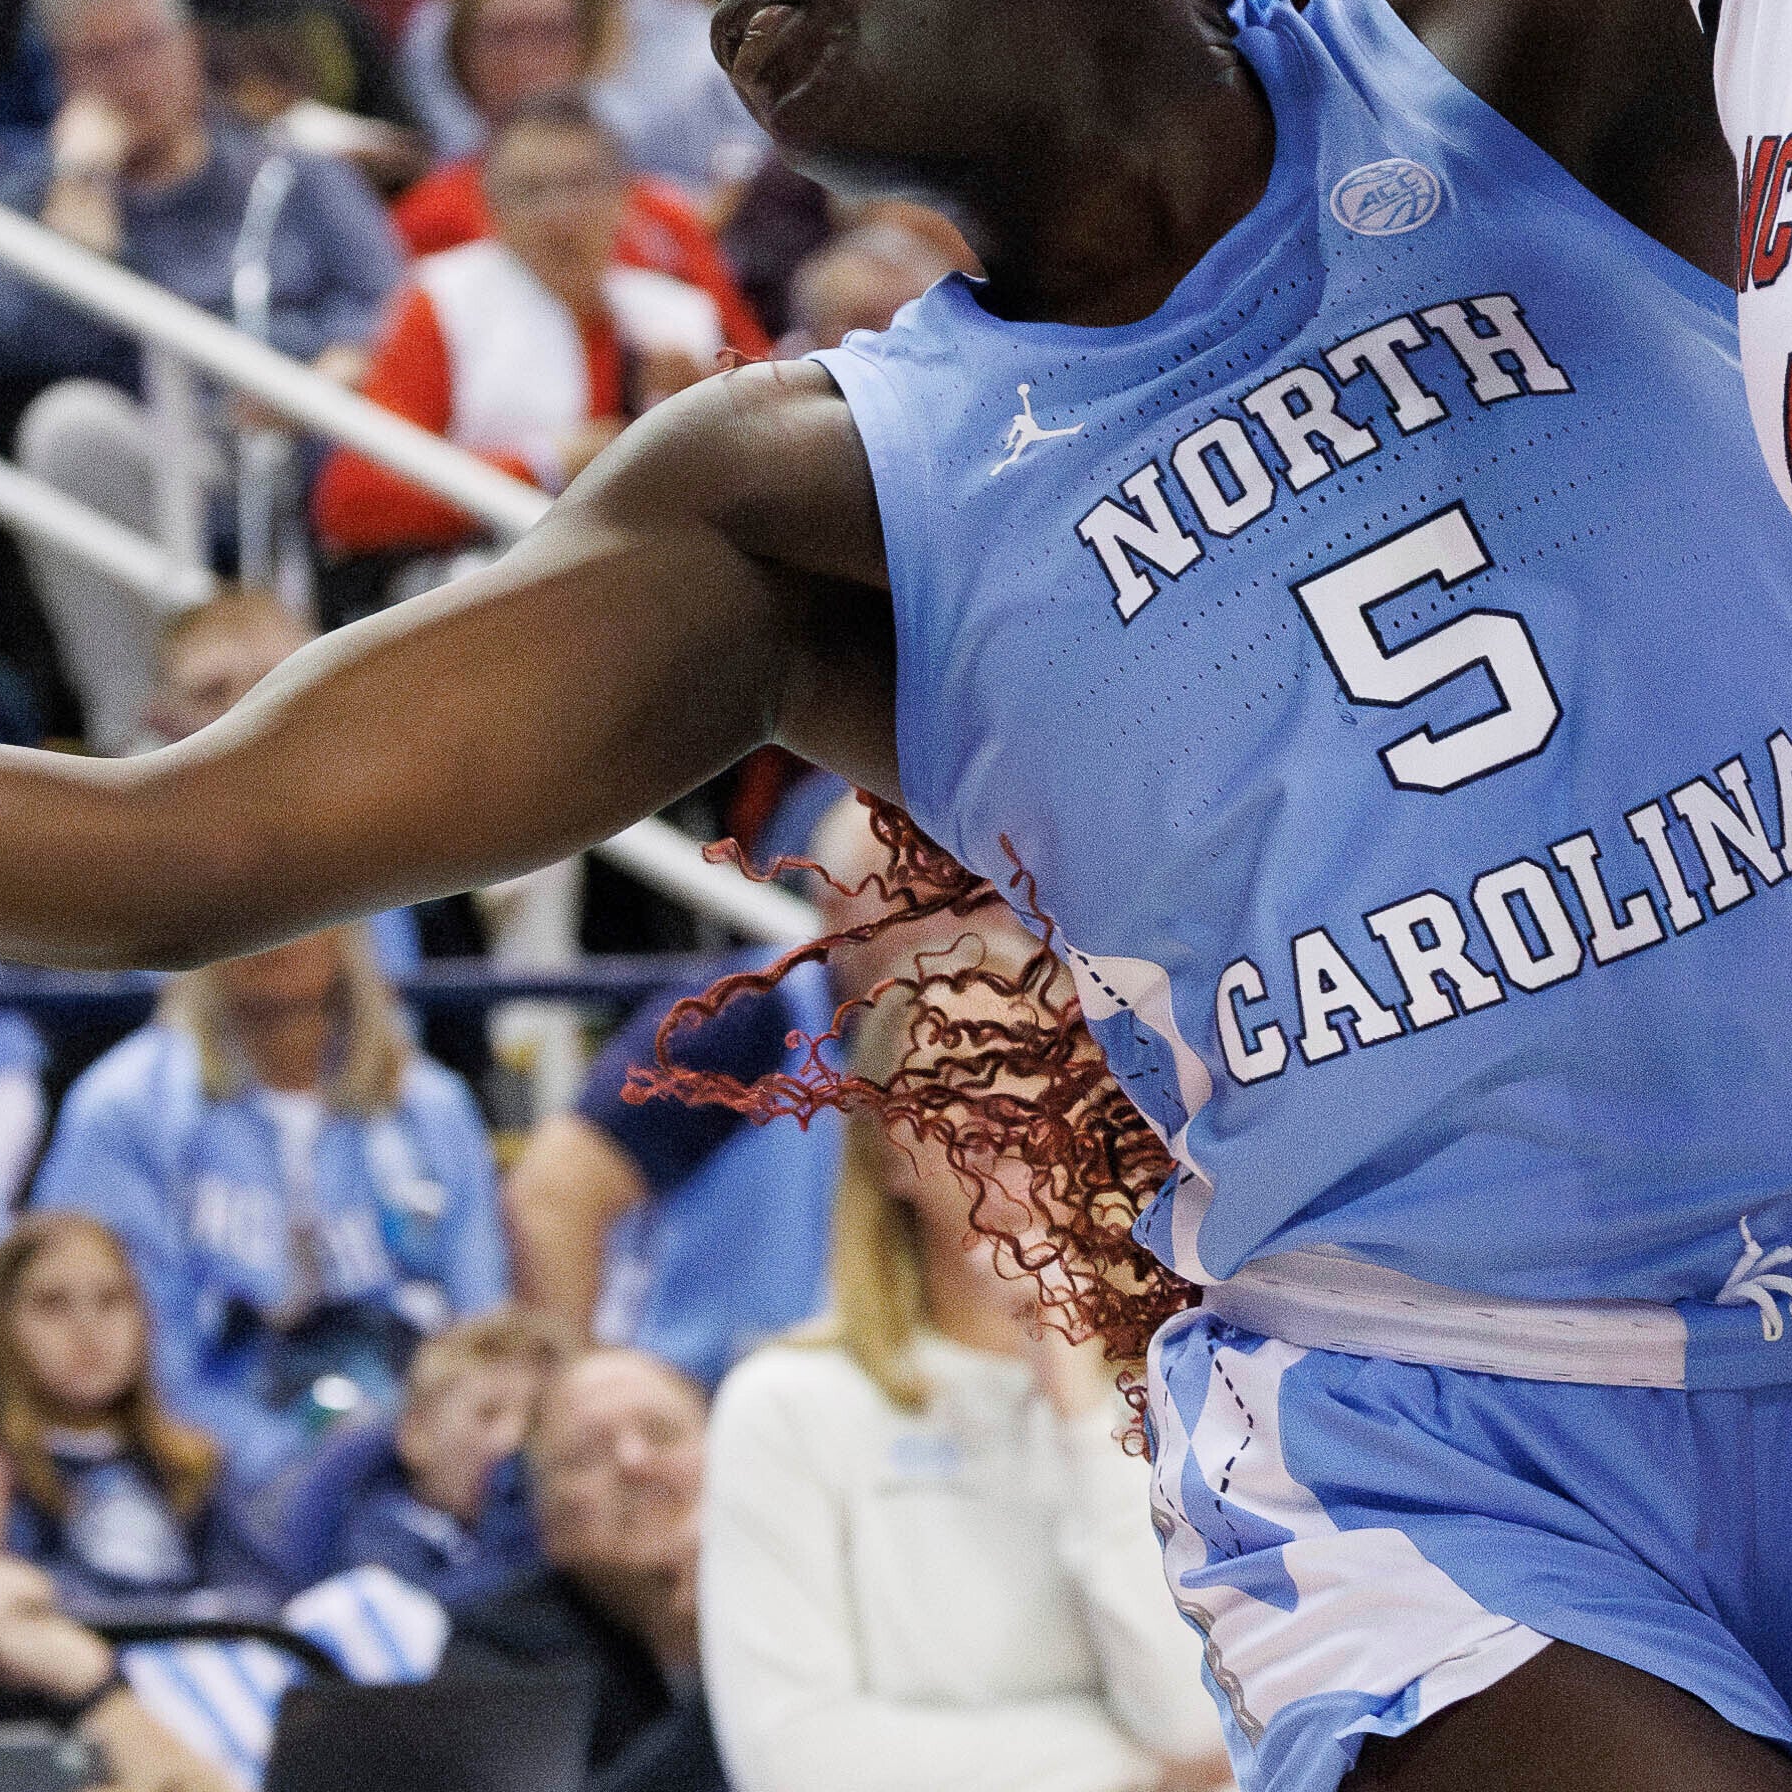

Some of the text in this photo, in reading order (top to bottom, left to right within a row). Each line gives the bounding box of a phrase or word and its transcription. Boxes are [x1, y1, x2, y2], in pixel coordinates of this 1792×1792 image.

[1357, 165, 1422, 212] ACC
[1073, 291, 1576, 627] NORTH
[1287, 499, 1564, 795] 5
